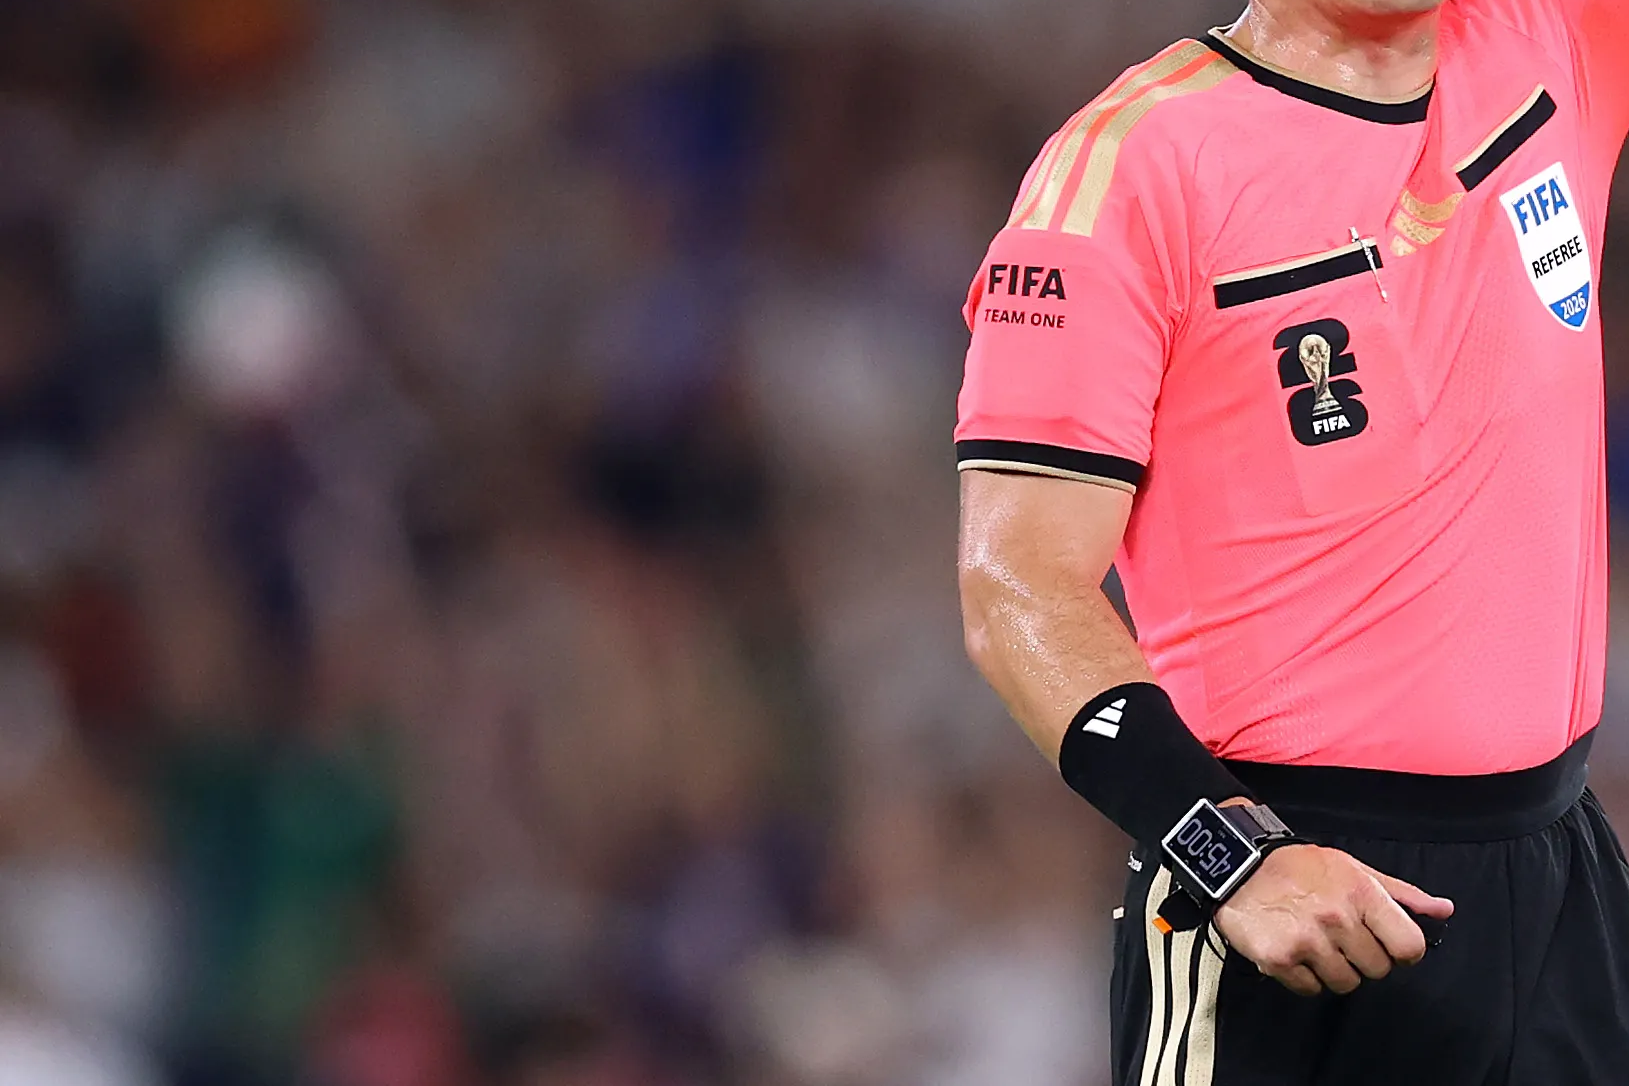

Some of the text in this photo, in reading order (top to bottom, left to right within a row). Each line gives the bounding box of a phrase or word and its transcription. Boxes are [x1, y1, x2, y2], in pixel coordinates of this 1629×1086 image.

[1512, 177, 1569, 235] FIFA
[1532, 235, 1583, 279] REFEREE
[988, 264, 1067, 300] FIFA
[984, 308, 1065, 329] TEAM ONE
[1560, 292, 1586, 320] 2026
[1312, 414, 1351, 435] FIFA
[1176, 818, 1232, 879] 45:00
